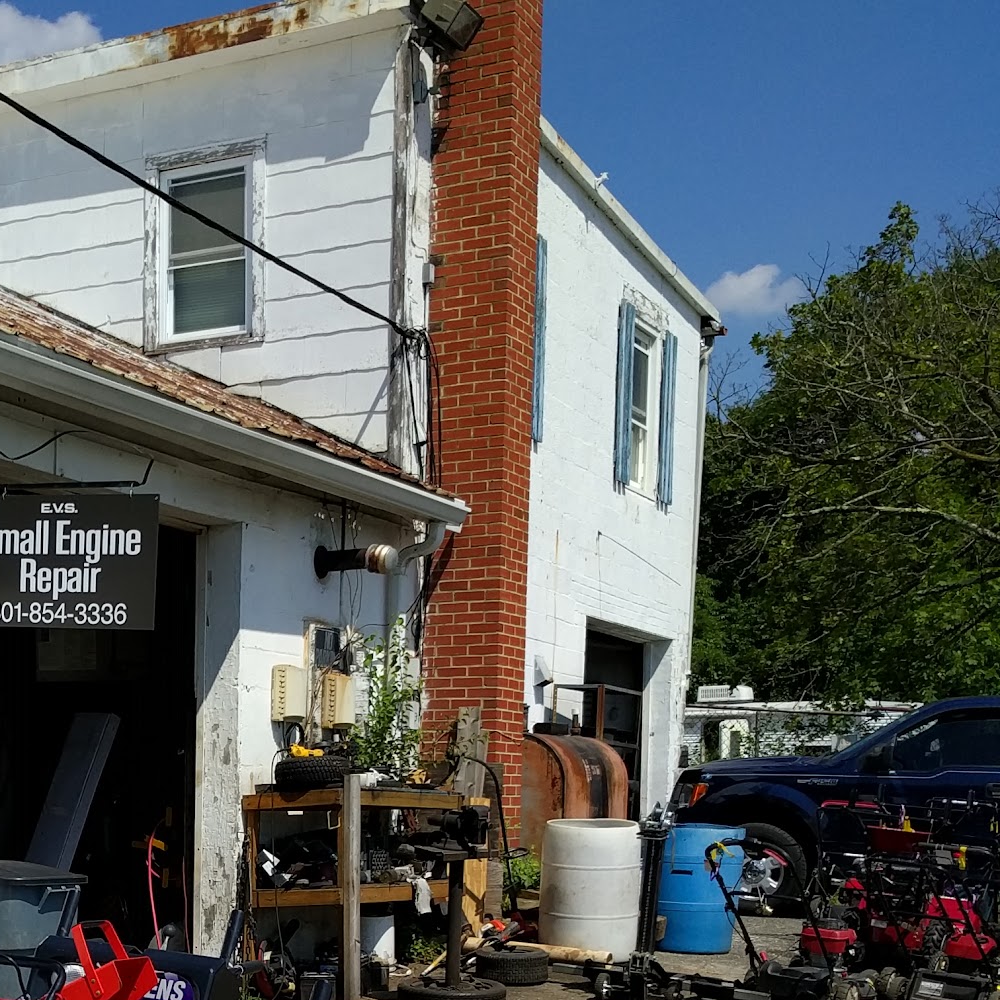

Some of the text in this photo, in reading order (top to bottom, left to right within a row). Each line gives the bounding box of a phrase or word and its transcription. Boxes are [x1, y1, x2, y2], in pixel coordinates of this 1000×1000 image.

[40, 503, 78, 513] E.V.S.
[55, 520, 141, 563] Engine
[19, 558, 101, 600] Repair
